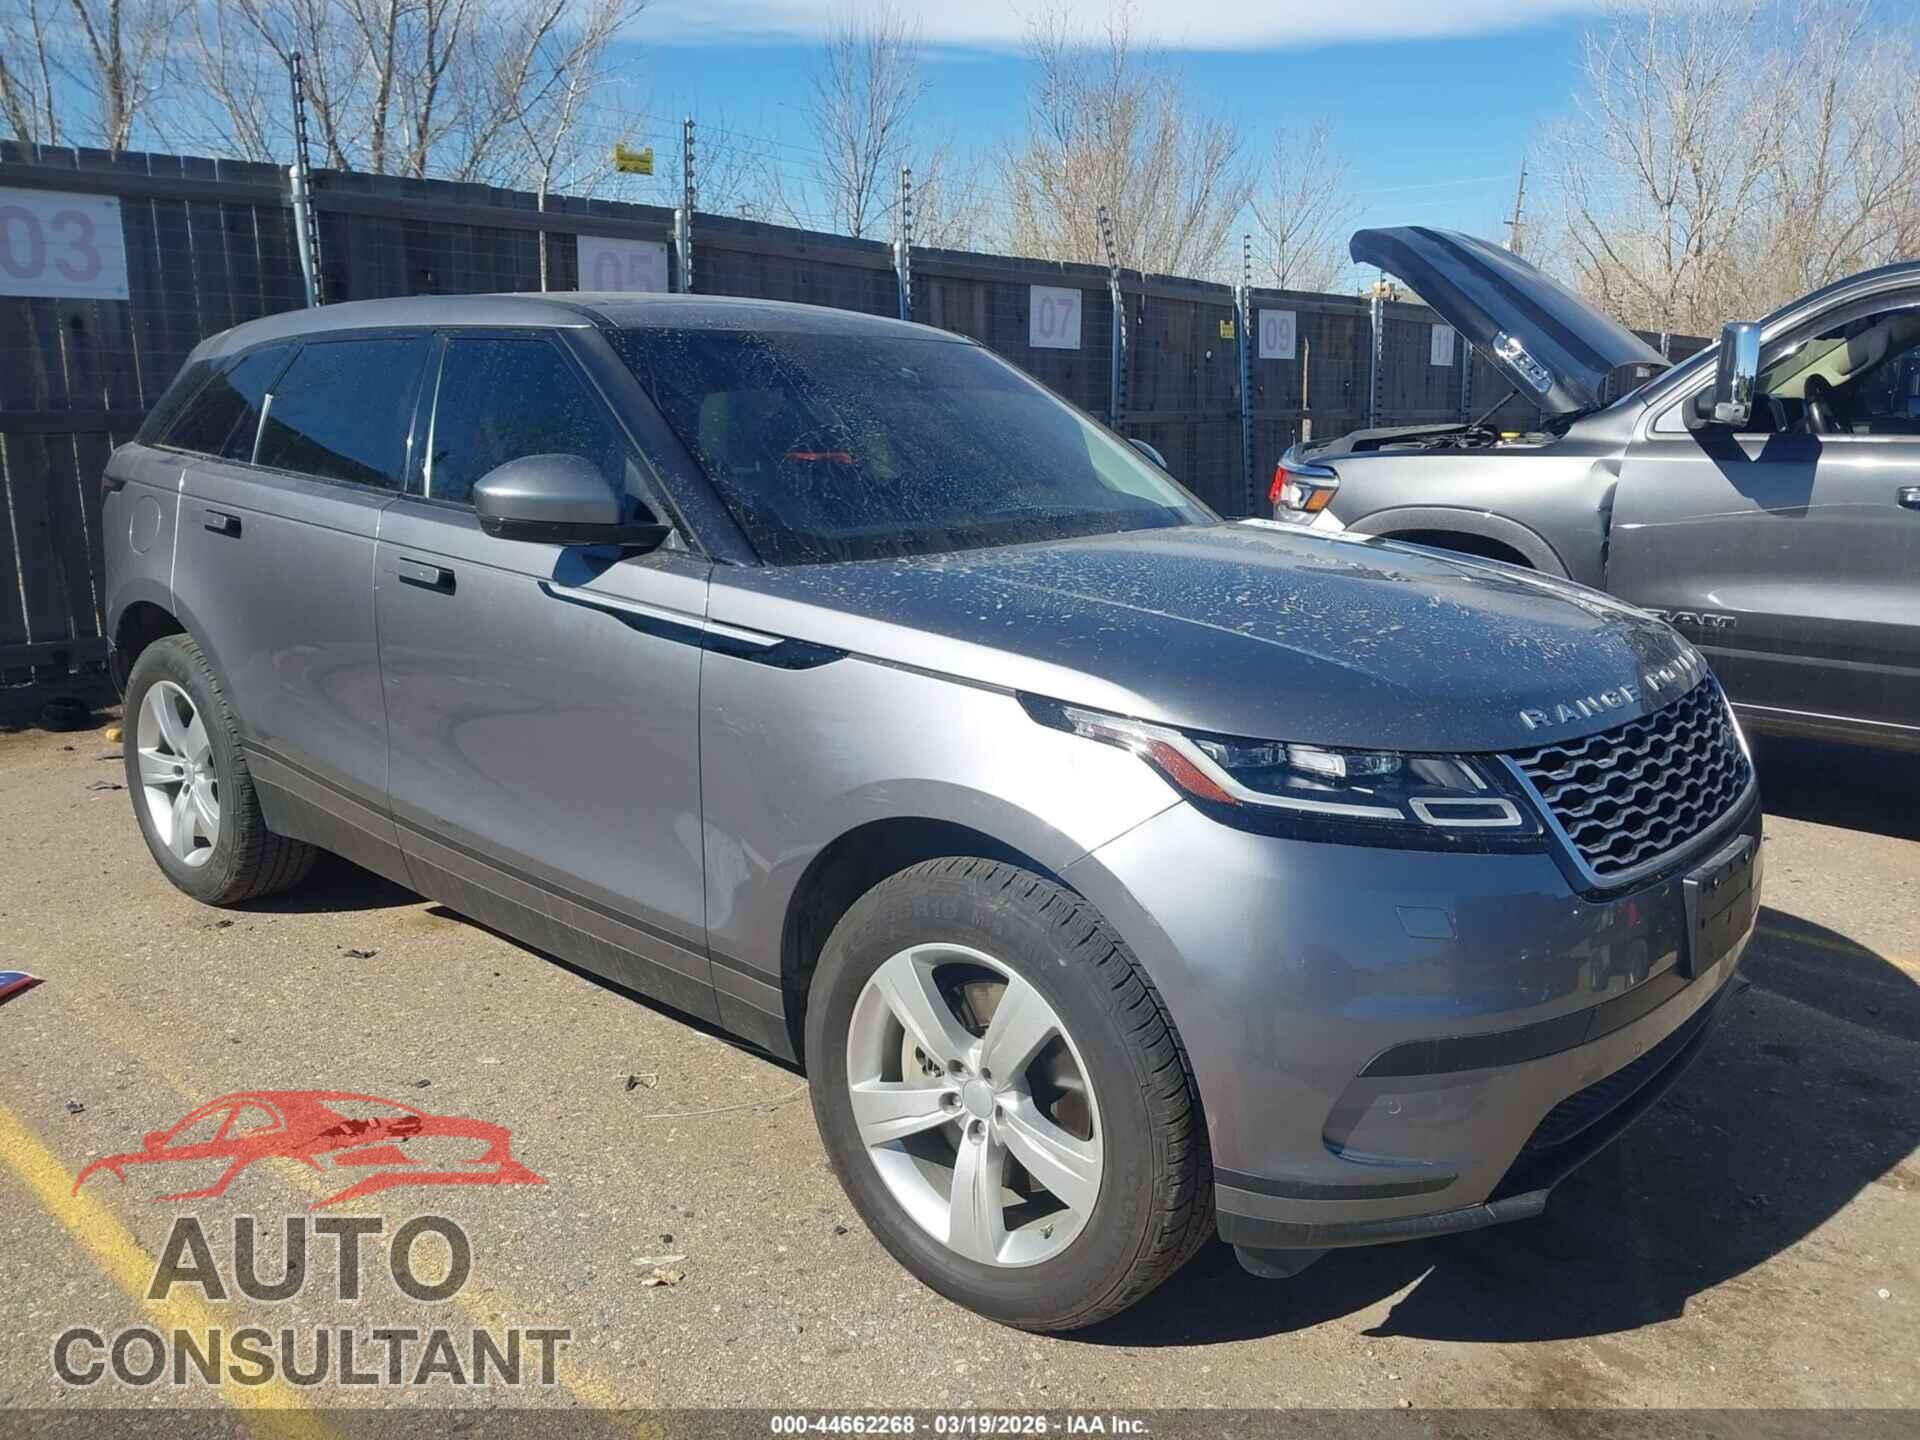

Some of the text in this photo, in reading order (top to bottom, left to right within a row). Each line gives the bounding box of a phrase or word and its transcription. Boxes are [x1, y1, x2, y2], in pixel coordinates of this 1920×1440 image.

[0, 206, 102, 282] 03
[1040, 296, 1073, 338] 07
[1266, 318, 1290, 351] 09
[1519, 684, 1641, 730] RANGE
